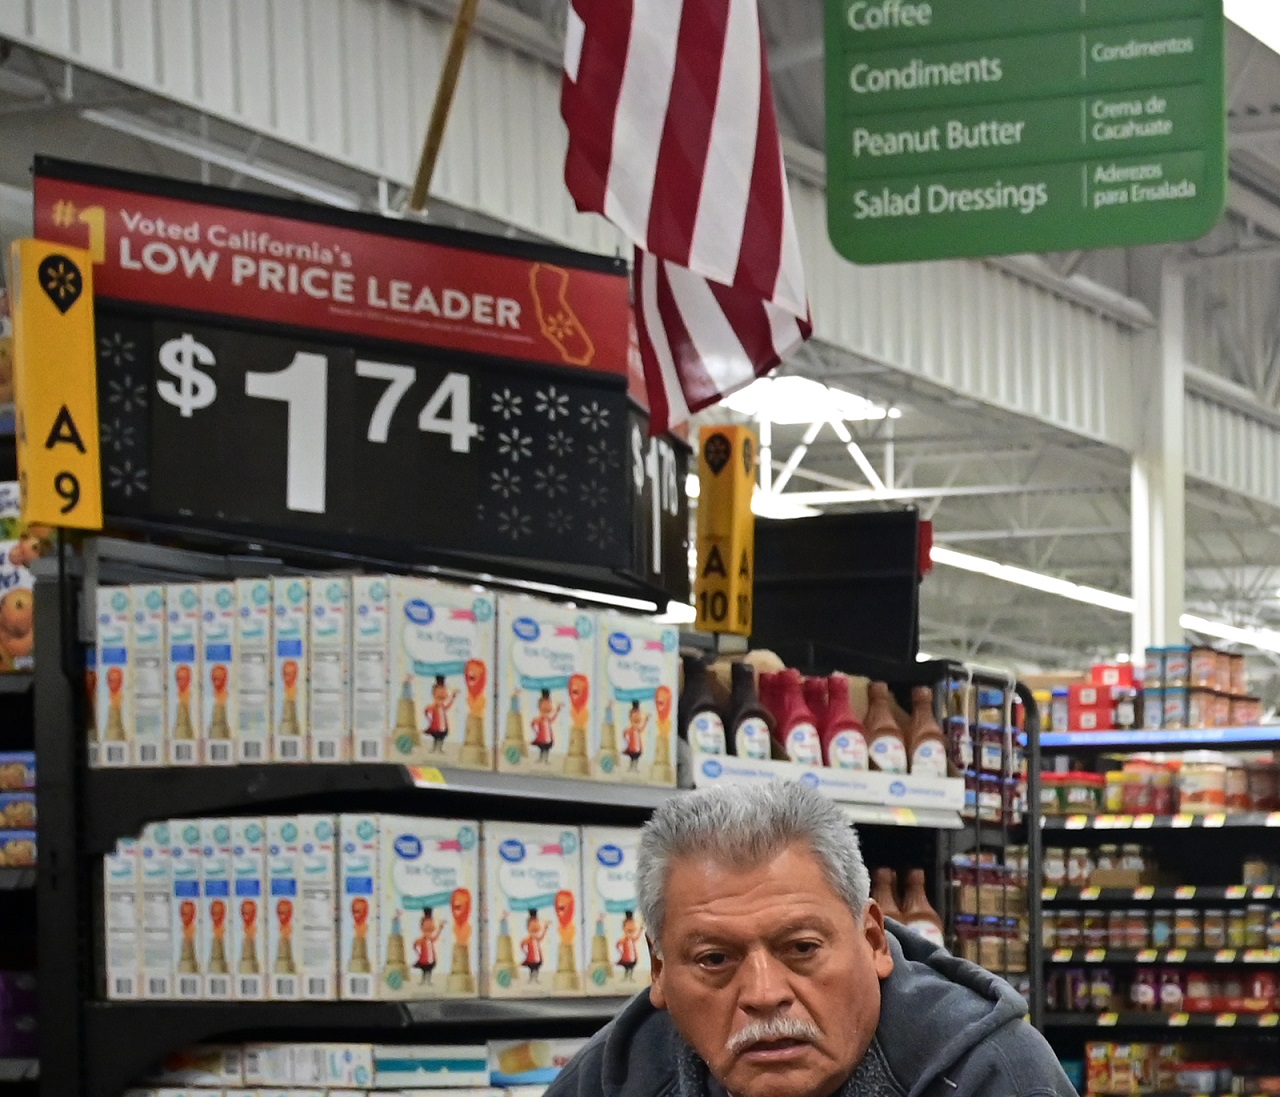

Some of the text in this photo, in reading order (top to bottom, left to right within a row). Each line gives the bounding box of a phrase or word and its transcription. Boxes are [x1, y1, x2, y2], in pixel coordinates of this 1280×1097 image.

[846, 1, 933, 31] Coffee
[1091, 35, 1193, 63] Condimentos
[849, 56, 1003, 94] Condiments
[1092, 96, 1166, 121] Crema de
[852, 119, 1025, 158] Peanut Butter
[1092, 118, 1173, 142] Cacahuate
[1093, 162, 1162, 184] Aderezos
[853, 180, 1048, 220] Salad Dressings
[120, 209, 352, 267] Voted California's
[119, 237, 219, 281] LOW
[231, 256, 355, 302] PRICE
[367, 279, 522, 330] LEADER
[44, 404, 87, 454] A
[55, 472, 81, 514] 9
[702, 545, 726, 578] A
[700, 591, 728, 622] 10
